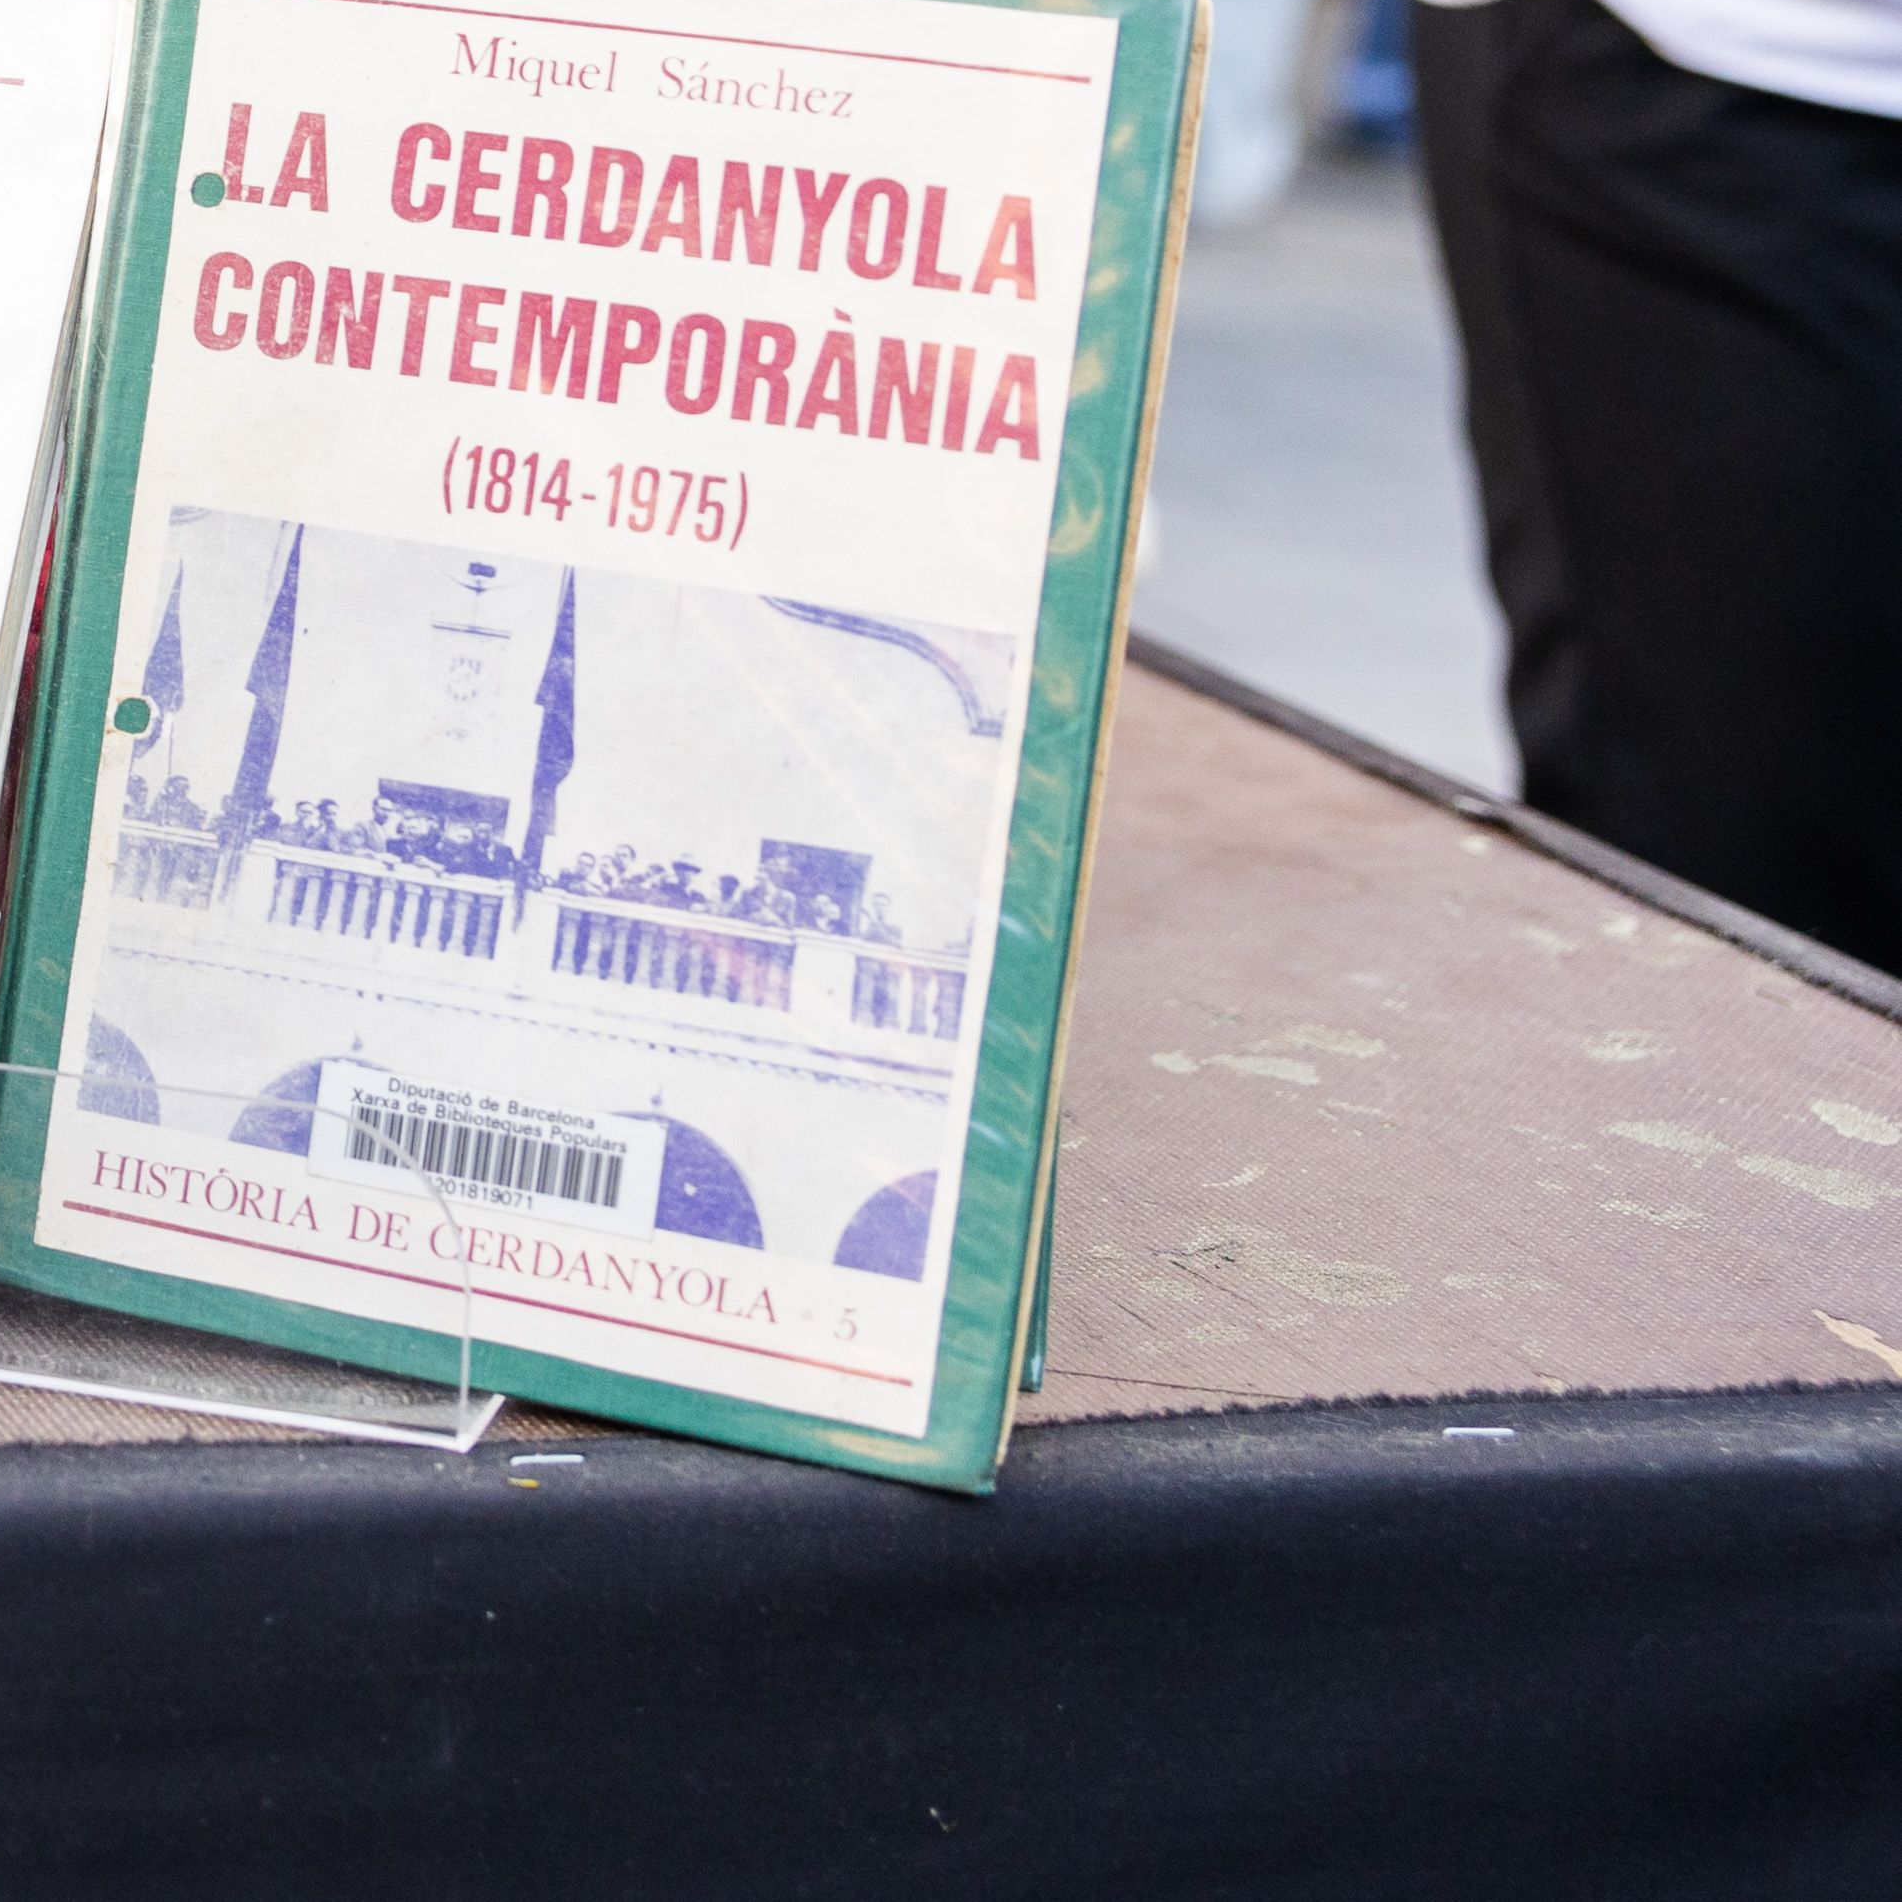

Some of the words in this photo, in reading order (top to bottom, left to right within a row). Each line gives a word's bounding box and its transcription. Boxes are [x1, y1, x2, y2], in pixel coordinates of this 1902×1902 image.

[450, 31, 618, 99] Miquel
[657, 54, 854, 121] Sánchez
[221, 102, 330, 213] LA
[390, 121, 1038, 303] CERDANYOLA
[192, 250, 1043, 463] CONTEMPORÀNIA
[441, 436, 751, 551] (1814-1975)
[351, 1087, 400, 1111] Xarxa
[406, 1098, 428, 1116] de
[435, 1103, 543, 1138] Biblioteques
[549, 1126, 628, 1154] Populars
[387, 1077, 473, 1106] Diputació
[479, 1096, 500, 1113] de
[507, 1100, 596, 1130] Barcelona
[346, 1202, 412, 1252] DE
[429, 1223, 780, 1326] CERDANYOLA
